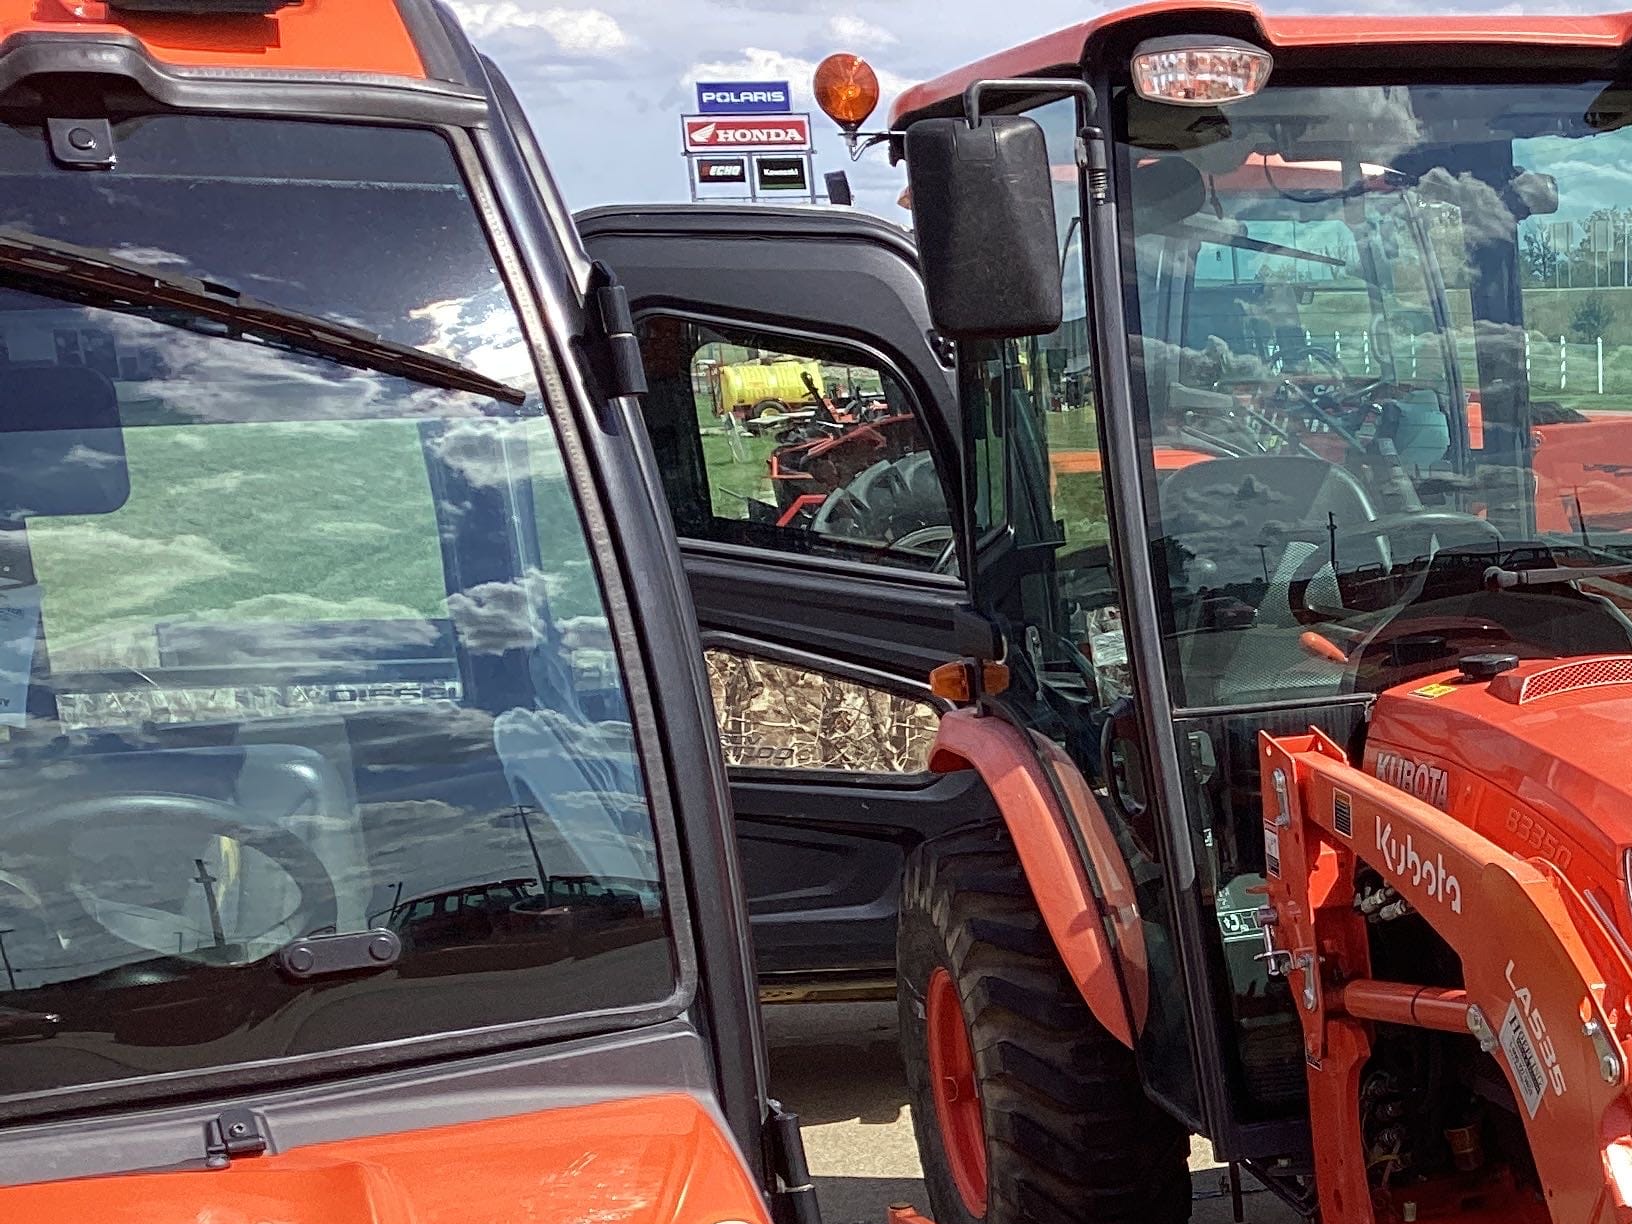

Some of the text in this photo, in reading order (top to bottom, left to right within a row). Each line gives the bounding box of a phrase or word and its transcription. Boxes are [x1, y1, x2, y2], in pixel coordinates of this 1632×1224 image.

[702, 91, 785, 103] POLARIS
[716, 128, 804, 142] HONDA
[709, 165, 741, 176] ECHO
[1376, 752, 1448, 812] KUBOTA
[1376, 815, 1462, 915] Kubota
[1506, 807, 1572, 869] B3350
[1505, 959, 1567, 1096] LA535
